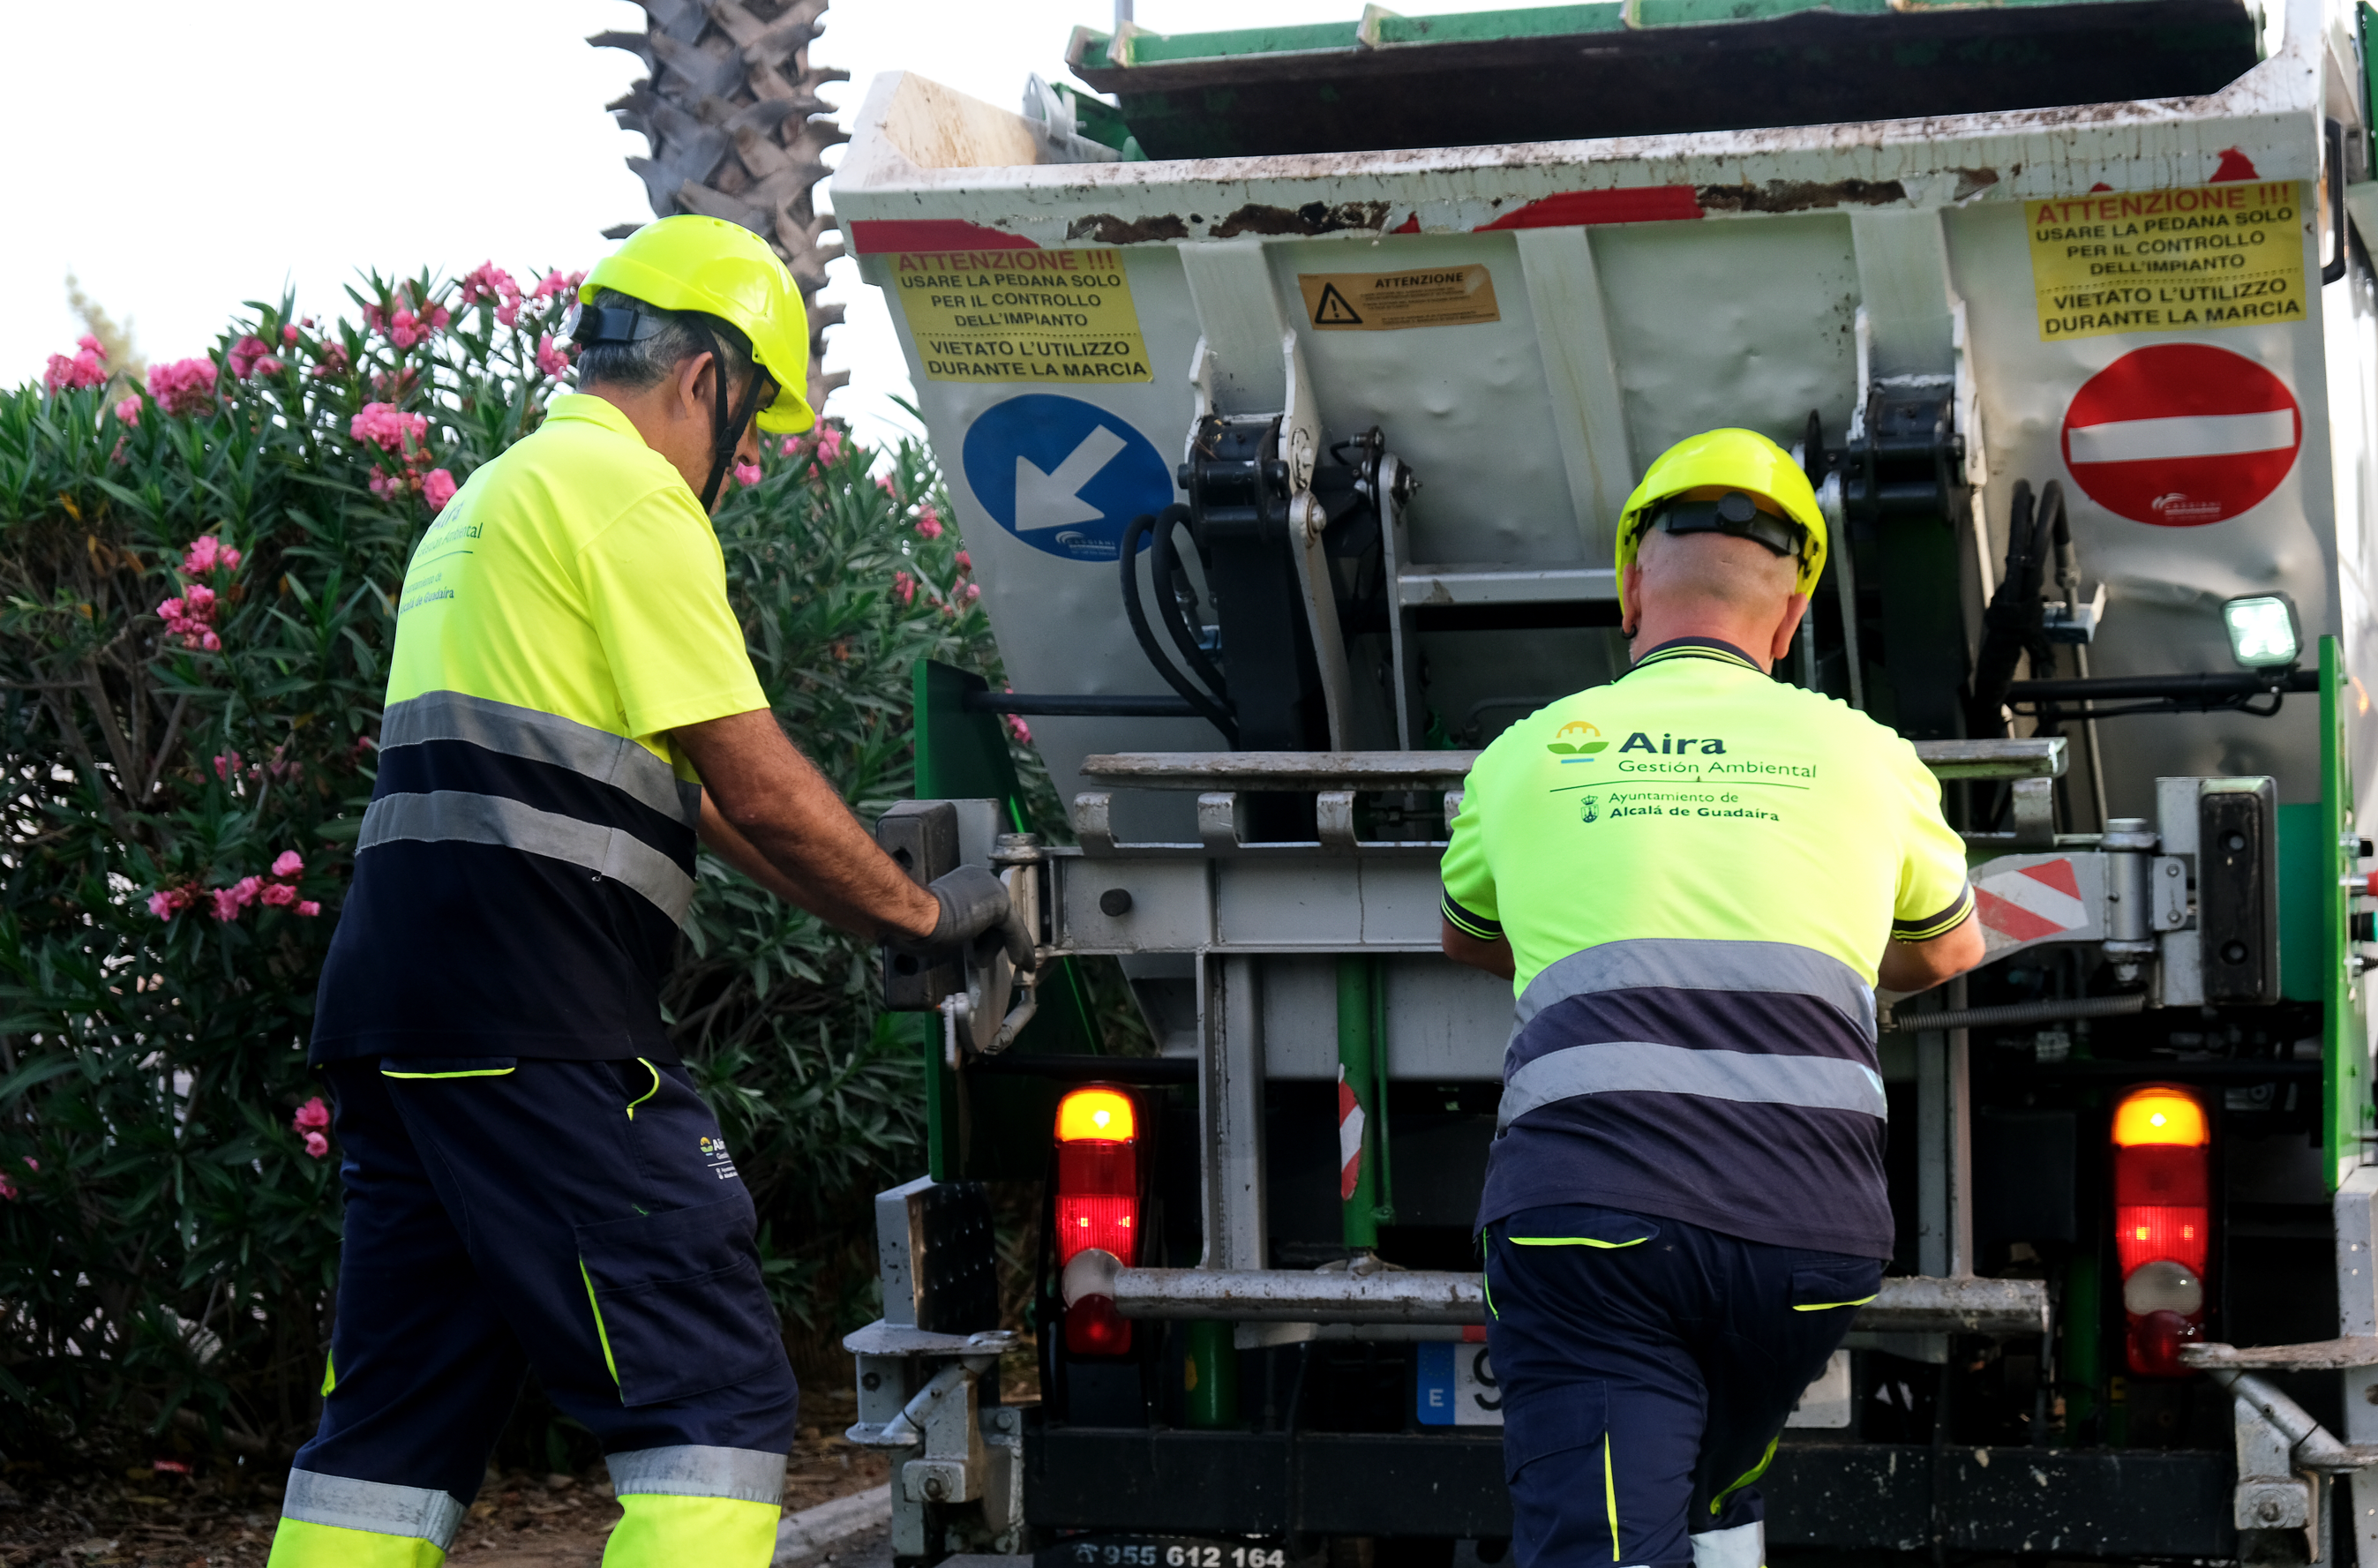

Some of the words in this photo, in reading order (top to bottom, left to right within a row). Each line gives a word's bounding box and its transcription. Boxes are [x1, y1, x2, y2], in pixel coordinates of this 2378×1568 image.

[2036, 187, 2247, 224] ATTENZIONE
[2259, 184, 2289, 206] !!!
[2036, 225, 2104, 243] USARE
[2112, 223, 2138, 237] LA
[2144, 214, 2230, 233] PEDANA
[2235, 206, 2292, 226] SOLO
[2067, 244, 2108, 258] PER
[2113, 243, 2131, 255] IL
[2137, 230, 2265, 254] CONTROLLO
[898, 250, 1078, 271] ATTENZIONE
[1085, 250, 1114, 269] !!!
[2090, 254, 2246, 276] DELL'IMPIANTO
[901, 275, 962, 289] USARE
[967, 274, 990, 287] LA
[995, 274, 1068, 287] PEDANA
[1071, 274, 1121, 287] SOLO
[1375, 273, 1464, 288] ATTENZIONE
[931, 295, 966, 308] PER
[971, 294, 987, 307] IL
[992, 293, 1101, 307] CONTROLLO
[2053, 288, 2151, 310] VIETATO
[2159, 278, 2286, 303] L'UTILIZZO
[955, 312, 1088, 327] DELL'IMPIANTO
[2045, 311, 2160, 334] DURANTE
[2168, 309, 2198, 324] LA
[2205, 299, 2300, 322] MARCIA
[929, 341, 1014, 356] VIETATO
[1019, 341, 1129, 356] L'UTILIZZO
[928, 360, 1026, 376] DURANTE
[1032, 363, 1059, 376] LA
[1063, 362, 1146, 377] MARCIA
[416, 596, 423, 606] de
[1618, 732, 1727, 754] Aira
[1618, 760, 1699, 773] Gestión
[1708, 761, 1816, 778] Ambiental
[1609, 792, 1714, 804] Ayuntamiento
[1721, 792, 1738, 803] de
[1609, 805, 1662, 819] Alcalá
[1669, 807, 1691, 816] de
[1697, 807, 1779, 822] Guadaíra
[1429, 1389, 1444, 1407] E
[1105, 1545, 1157, 1565] 955
[1166, 1546, 1221, 1567] 612
[1231, 1548, 1285, 1568] 164
